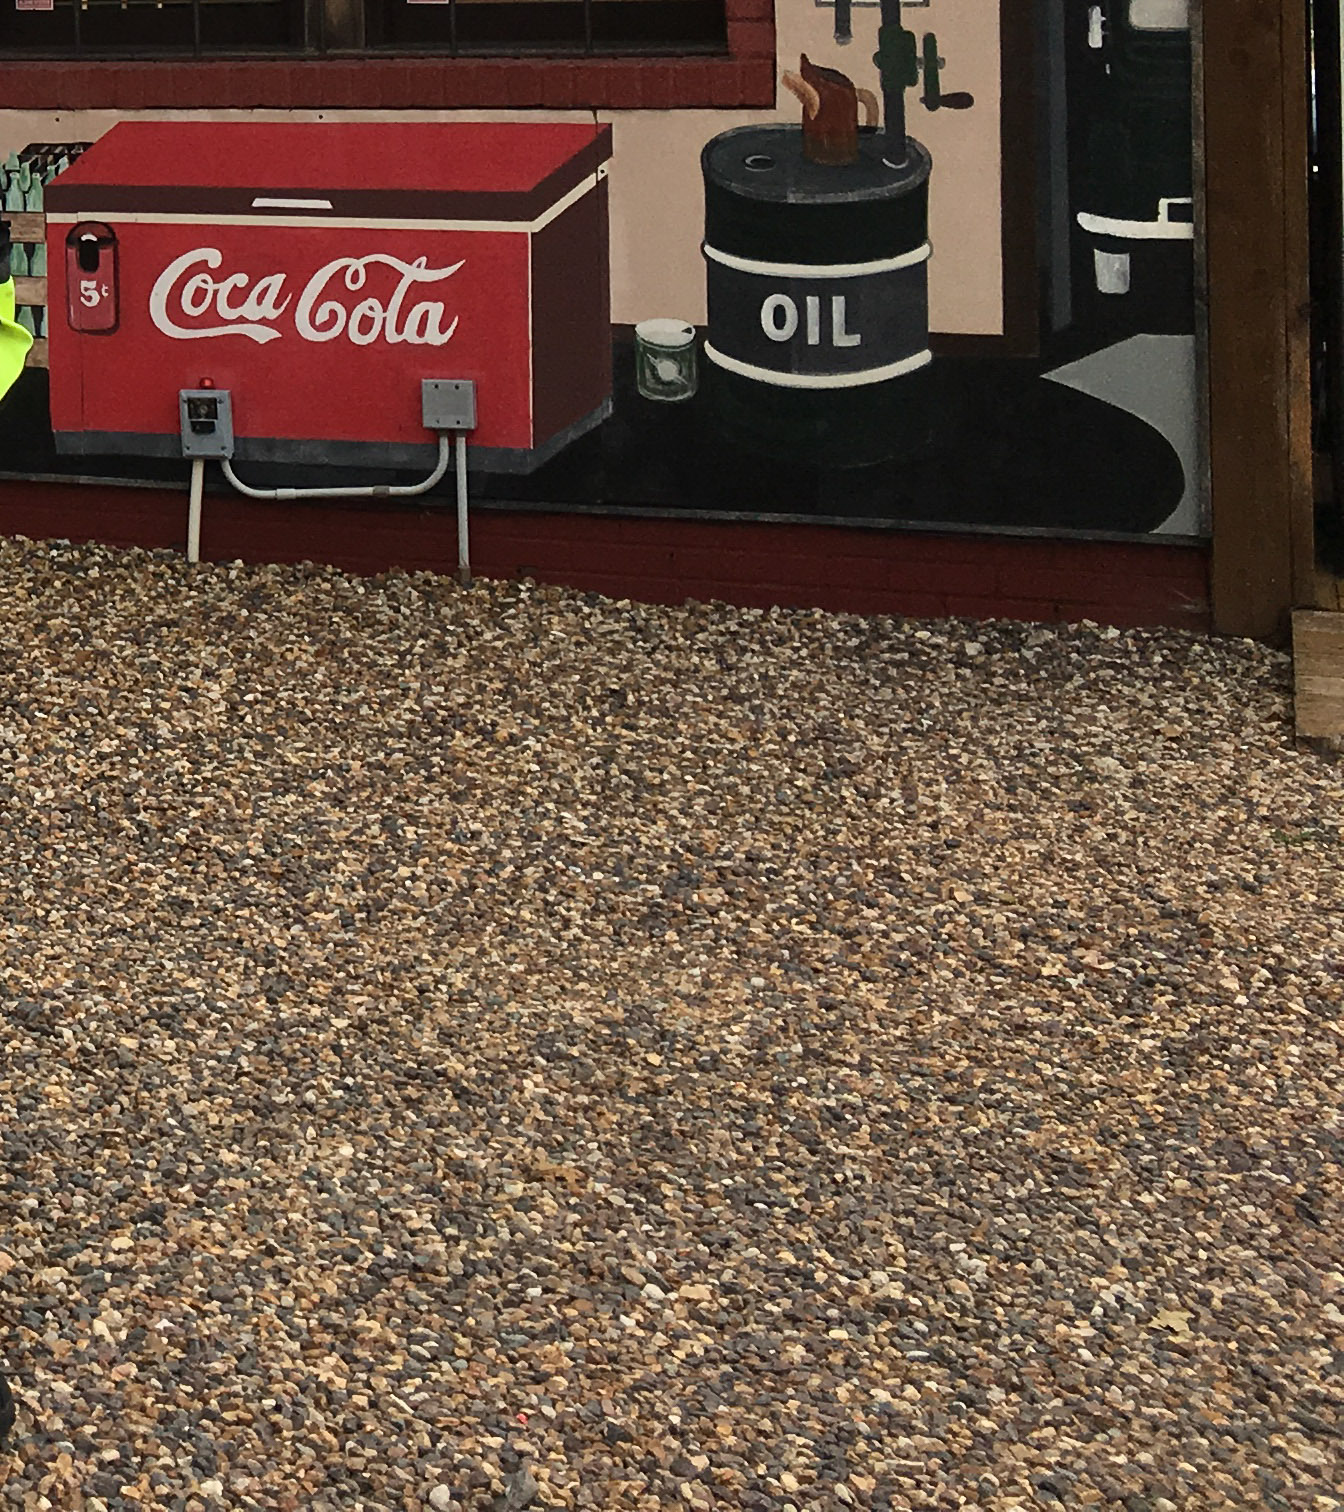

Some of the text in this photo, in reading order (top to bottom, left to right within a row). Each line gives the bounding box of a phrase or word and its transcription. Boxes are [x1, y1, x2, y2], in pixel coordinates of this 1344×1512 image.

[149, 247, 466, 345] Coca Cola
[760, 294, 862, 347] OIL
